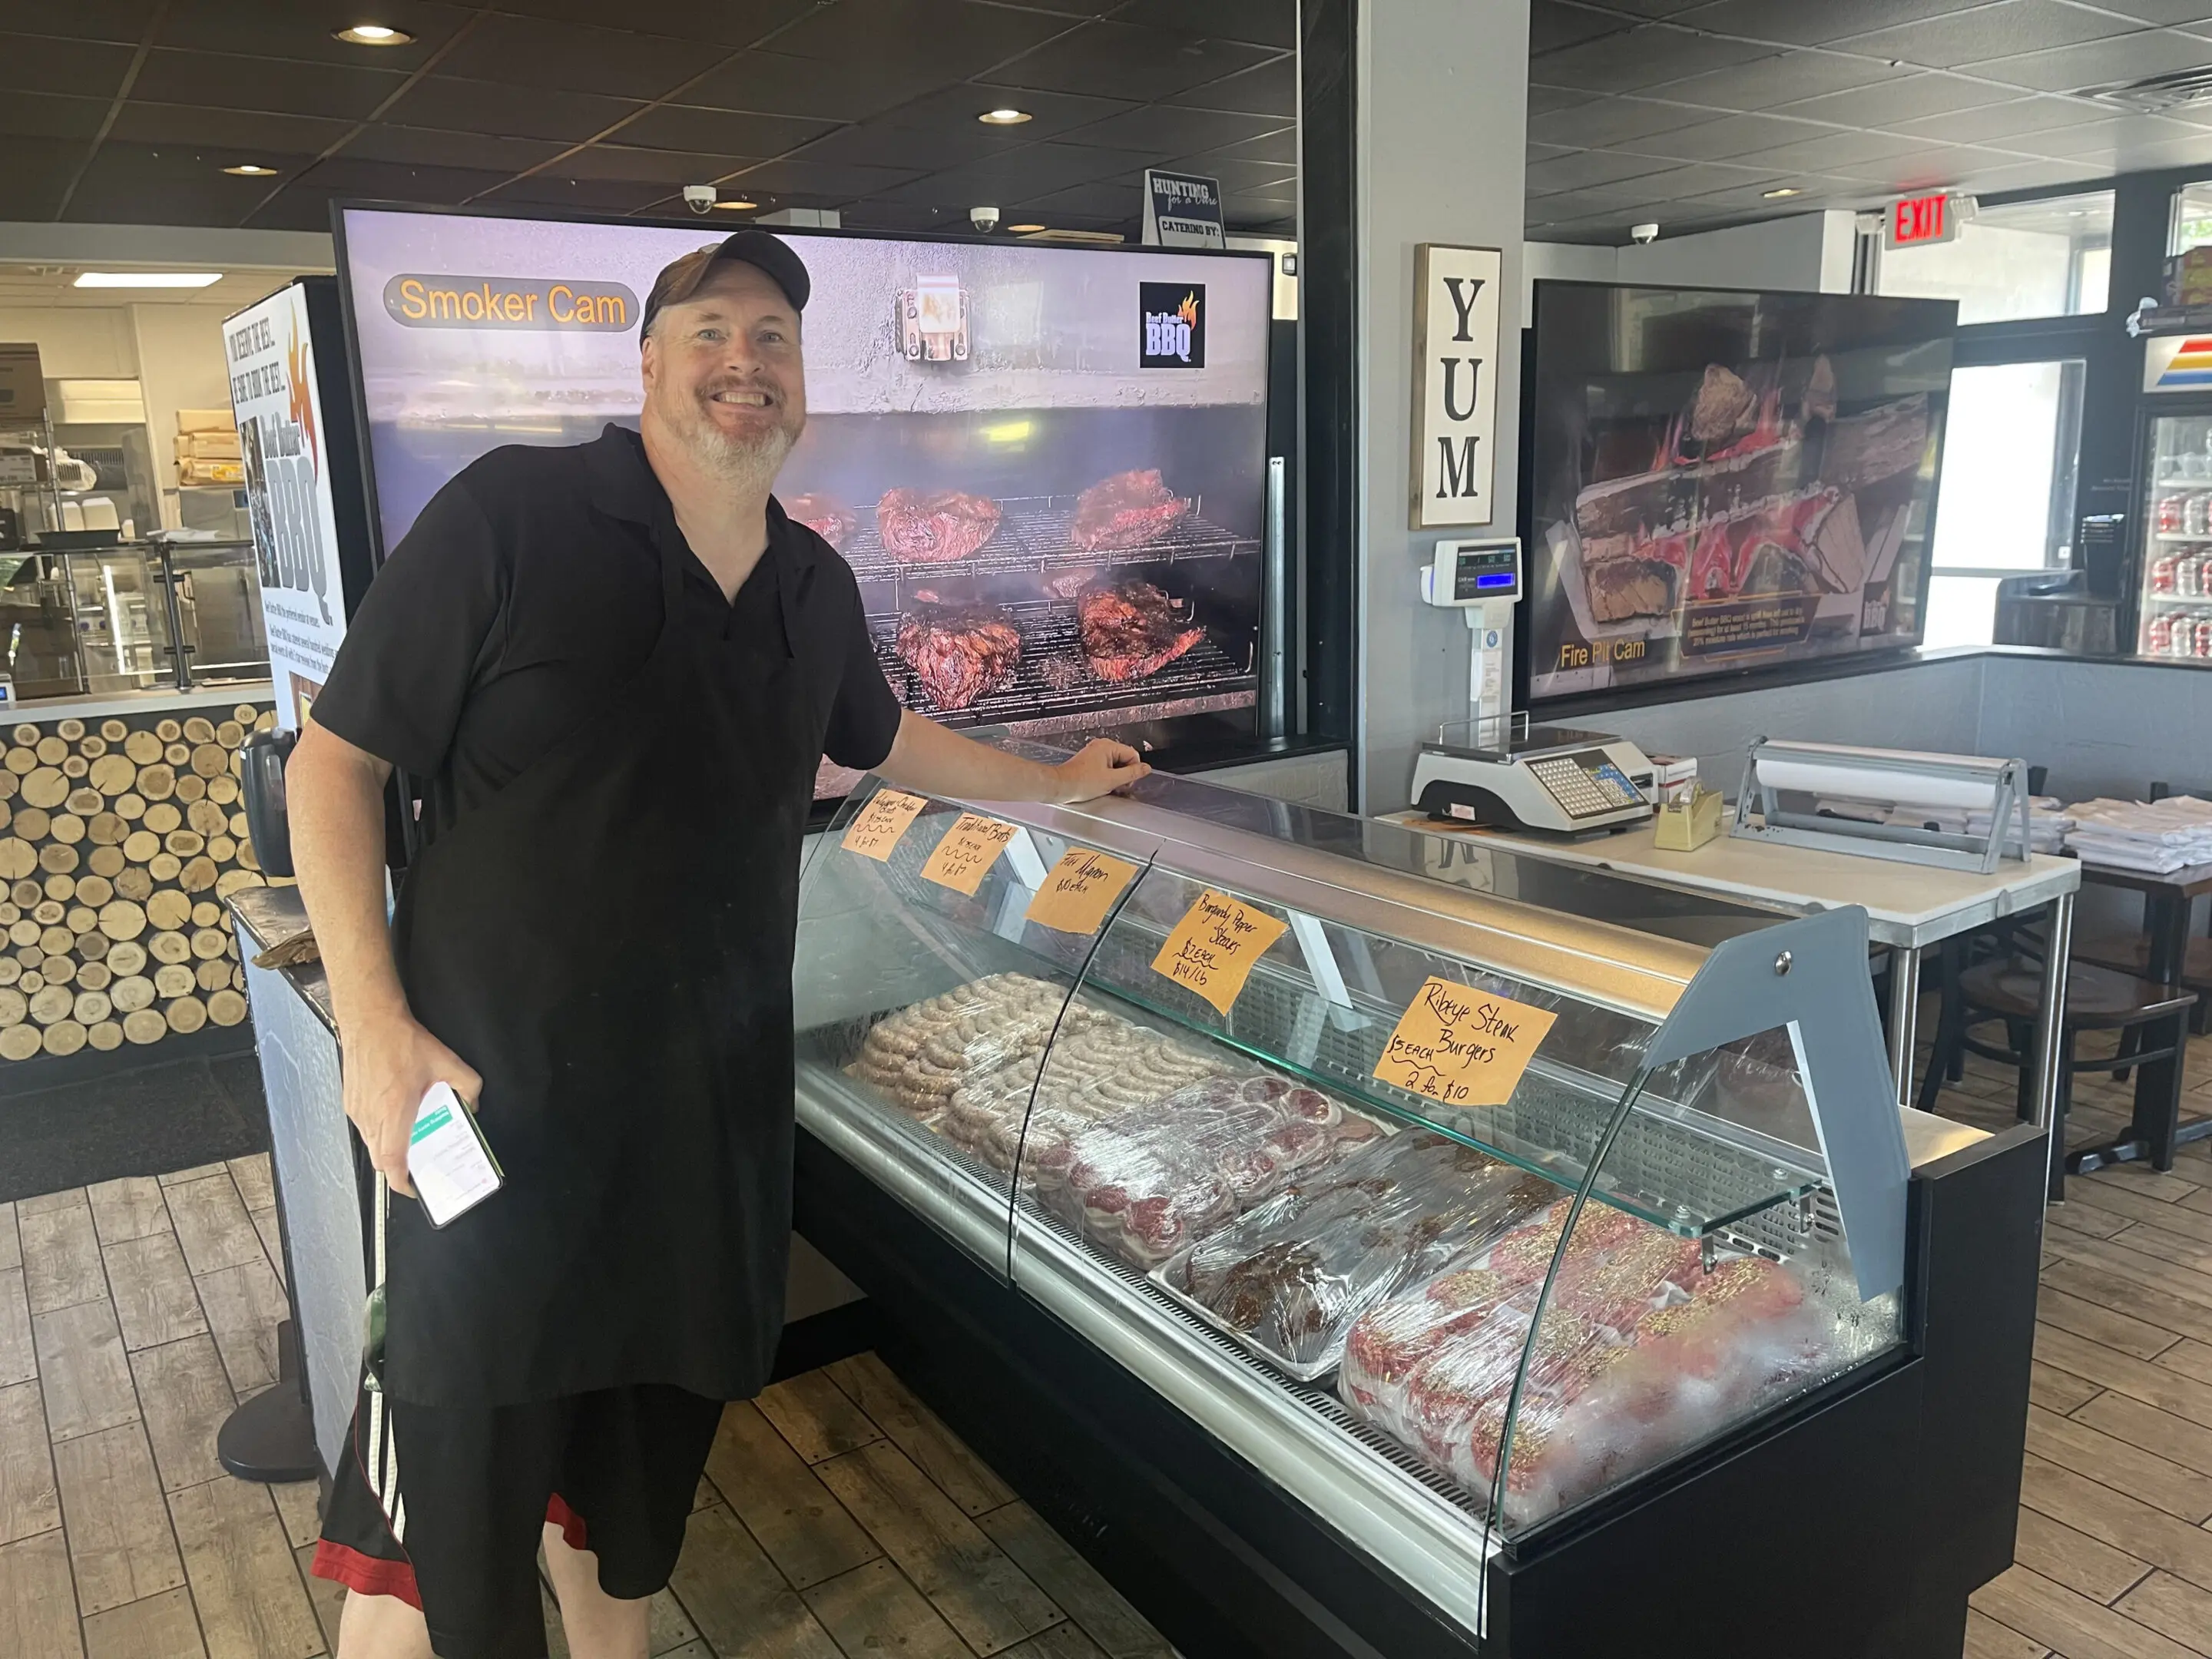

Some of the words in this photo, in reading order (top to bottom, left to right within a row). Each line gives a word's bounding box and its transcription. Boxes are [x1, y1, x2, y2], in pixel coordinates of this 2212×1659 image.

[1153, 177, 1209, 198] HUNTING
[1162, 220, 1204, 235] CATERING
[1204, 225, 1220, 237] BY:
[1895, 194, 1948, 243] EXIT
[399, 279, 538, 321] Smoker
[548, 285, 627, 324] Cam
[1145, 311, 1162, 323] Beef
[1145, 323, 1190, 363] BBQ
[1435, 276, 1486, 498] YUM
[266, 456, 329, 624] BBQ
[1561, 642, 1588, 667] Fire
[1614, 637, 1646, 661] Cam
[1075, 853, 1109, 888] Mignon
[1194, 948, 1217, 964] EACH
[1404, 1041, 1435, 1062] EACH
[1435, 1028, 1496, 1069] Burgers
[1405, 1071, 1419, 1090] 2
[1420, 1075, 1439, 1096] for
[1442, 1079, 1470, 1103] $10
